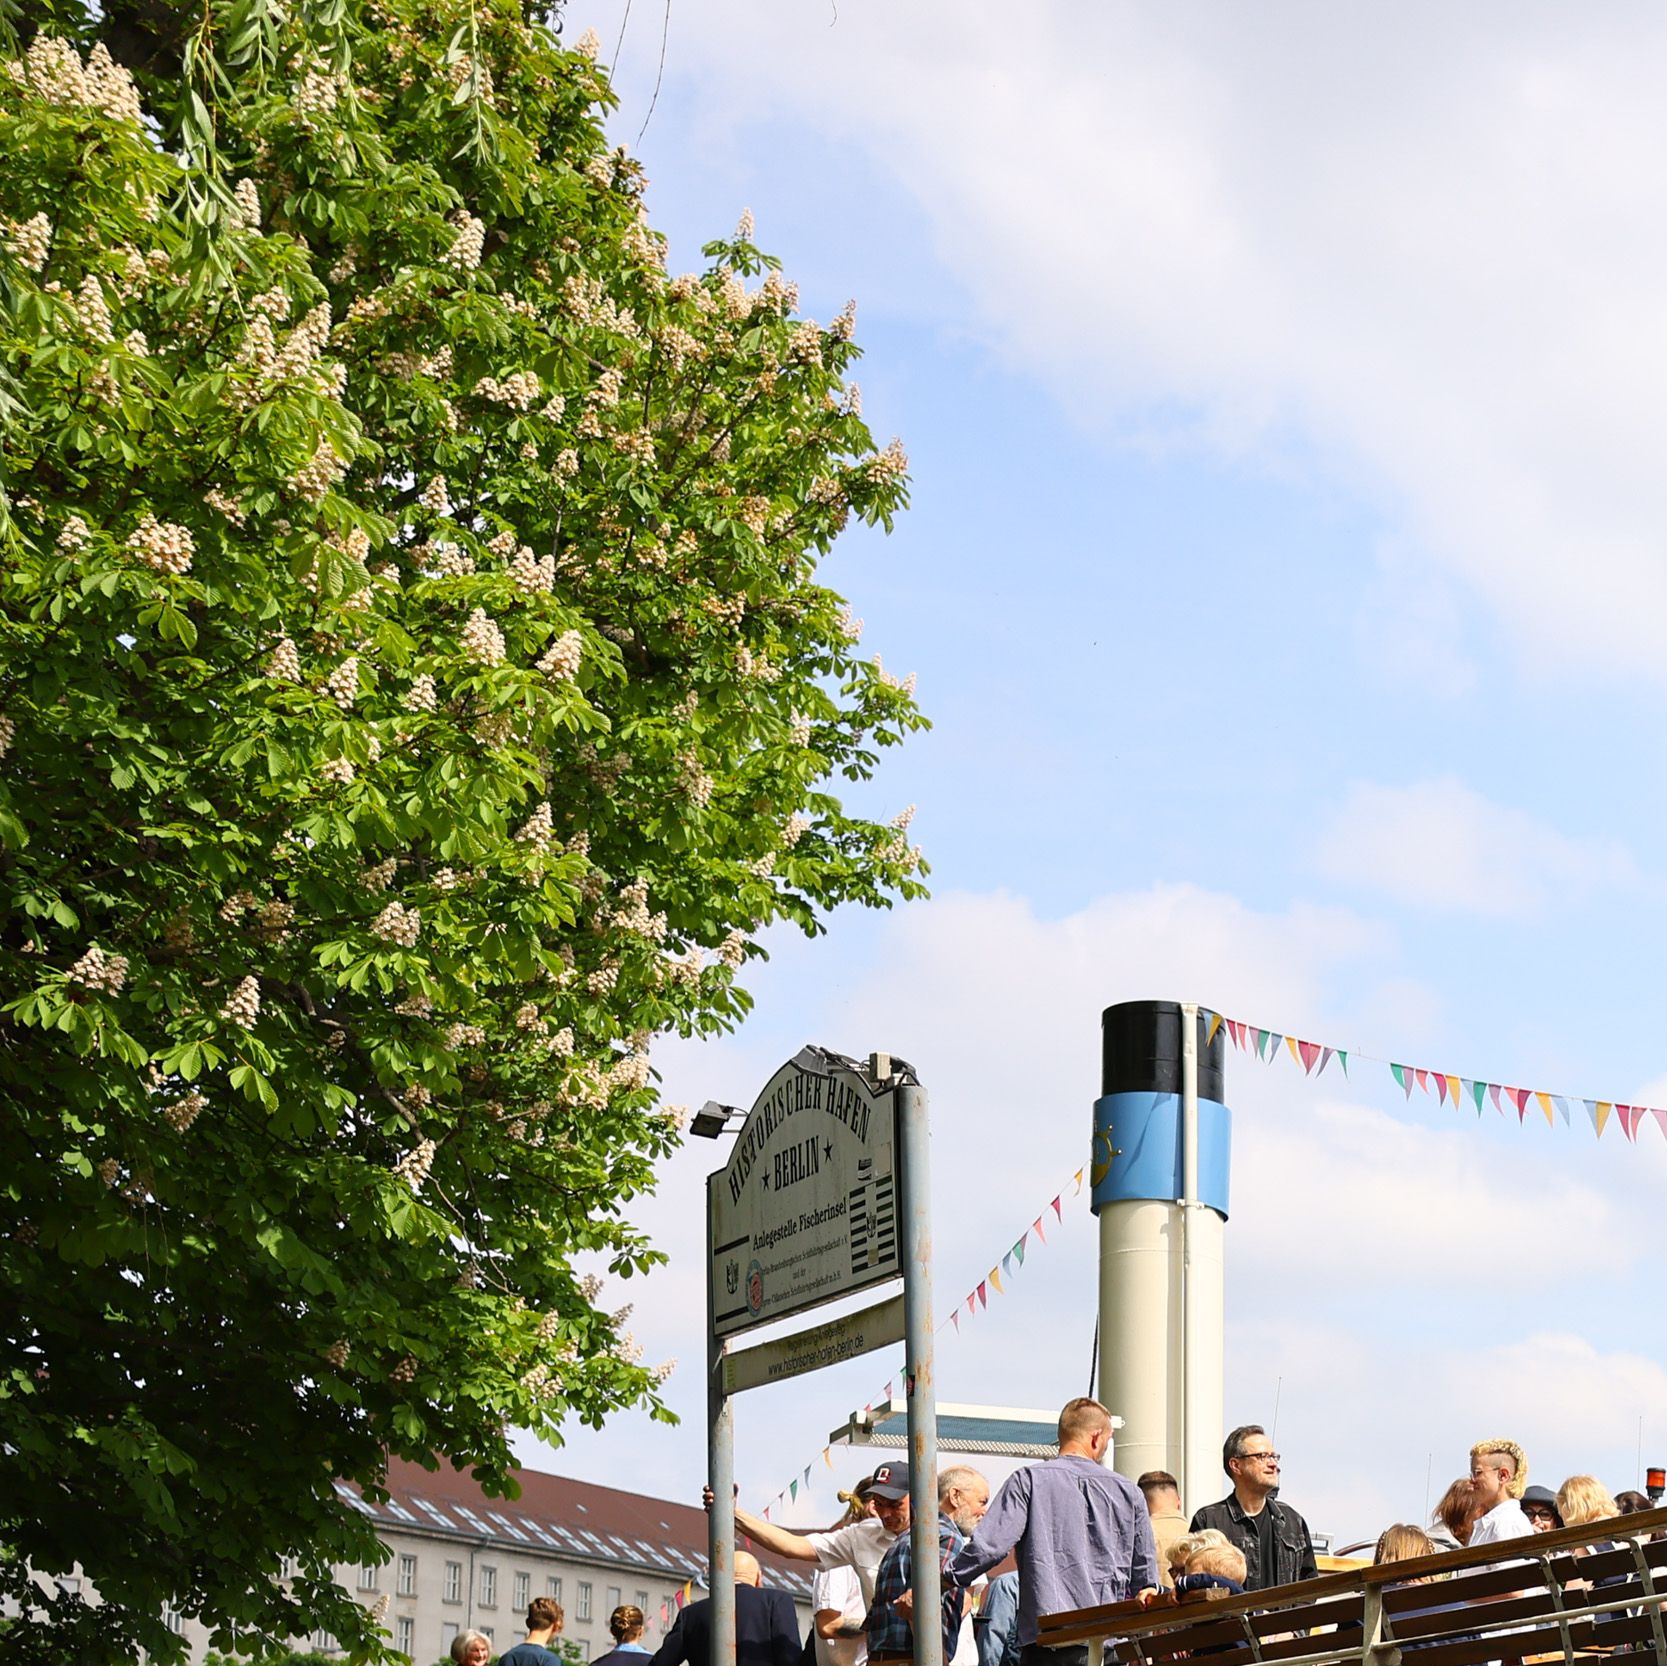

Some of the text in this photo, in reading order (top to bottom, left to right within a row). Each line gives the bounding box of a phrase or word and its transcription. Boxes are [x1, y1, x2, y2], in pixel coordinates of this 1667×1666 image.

[728, 1073, 871, 1207] HISTORISCHER HAFEN
[774, 1134, 820, 1193] BERLIN
[752, 1196, 847, 1251] Anlegestelle Fischerinsel
